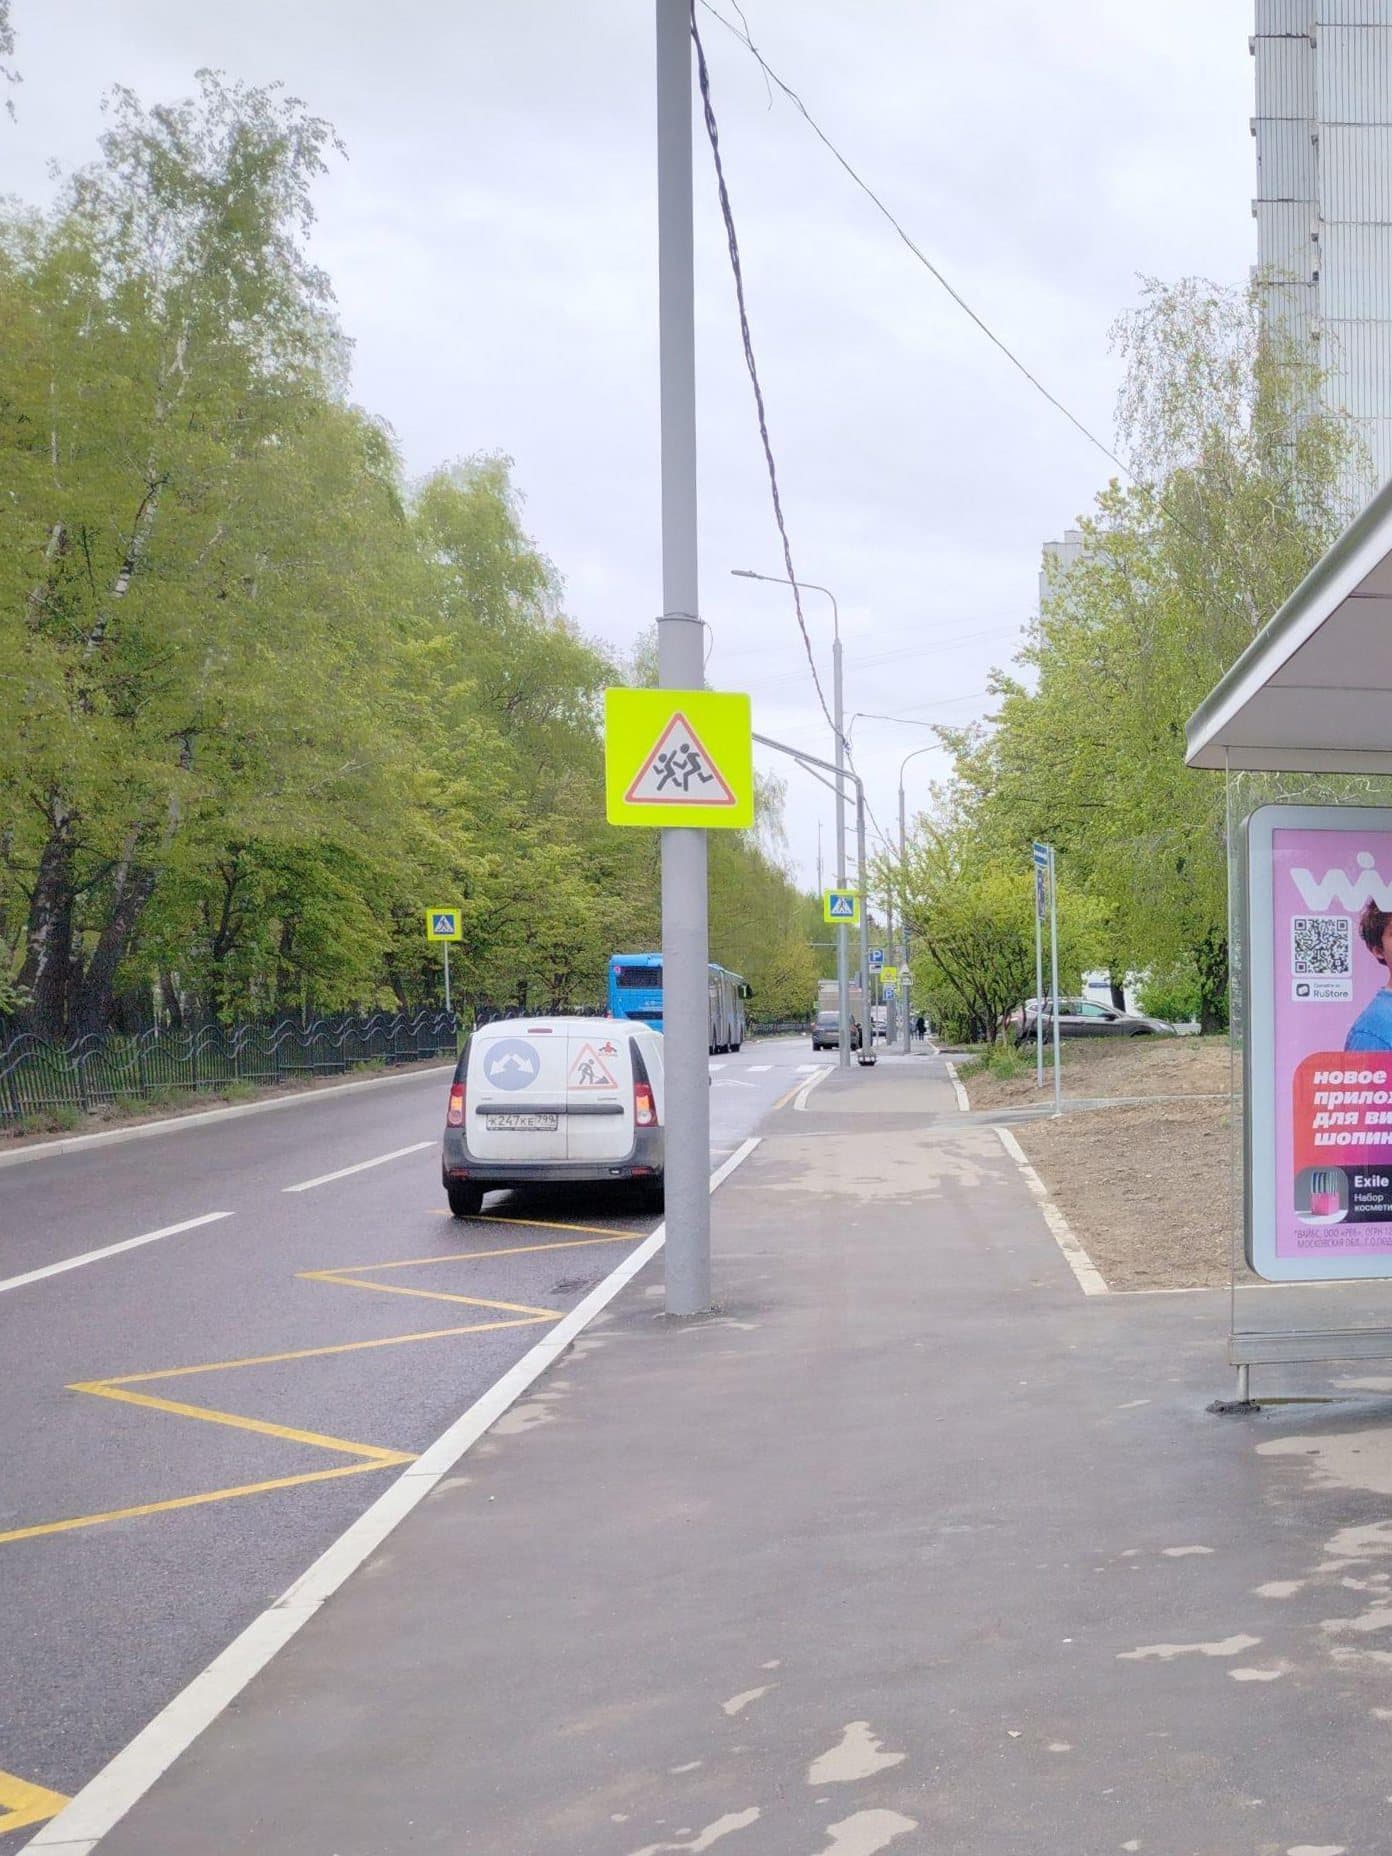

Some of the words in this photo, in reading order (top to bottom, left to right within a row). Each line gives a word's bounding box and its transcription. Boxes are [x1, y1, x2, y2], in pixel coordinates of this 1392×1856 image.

[1313, 990, 1349, 999] RuStore
[1313, 1069, 1387, 1086] новое
[1313, 1112, 1360, 1129] для
[1354, 1175, 1389, 1188] Exile
[1354, 1193, 1384, 1203] Набор
